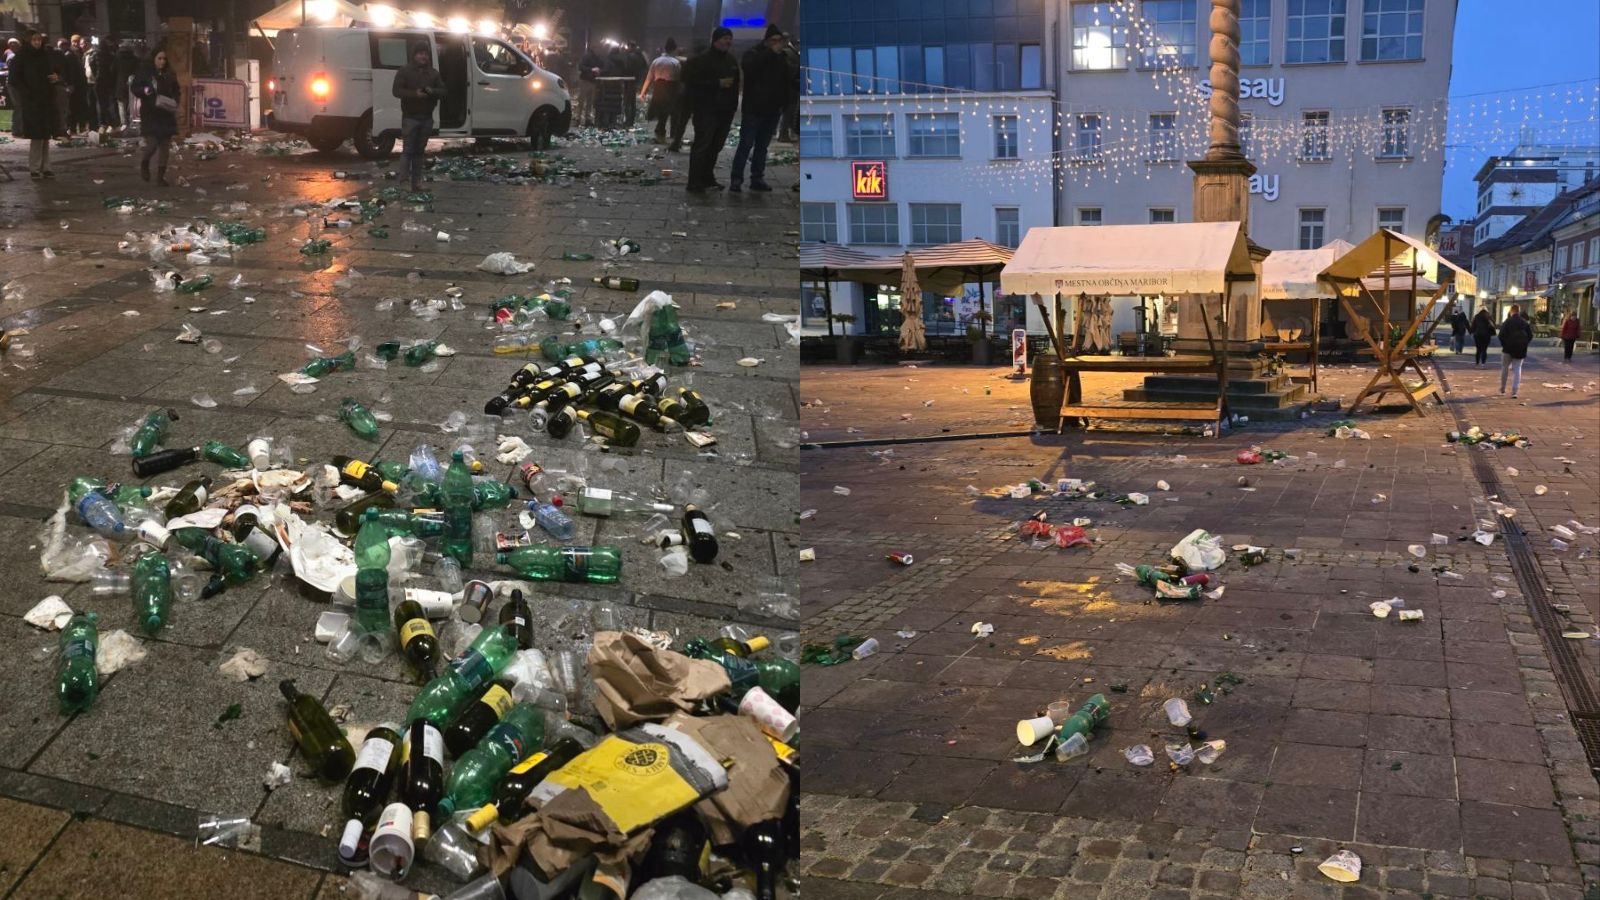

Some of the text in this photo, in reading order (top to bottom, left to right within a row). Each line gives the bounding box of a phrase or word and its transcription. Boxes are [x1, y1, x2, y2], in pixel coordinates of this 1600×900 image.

[1200, 77, 1284, 106] ssay
[857, 166, 882, 193] kik
[1065, 278, 1168, 288] MESTNA OBČINA MARIBOR
